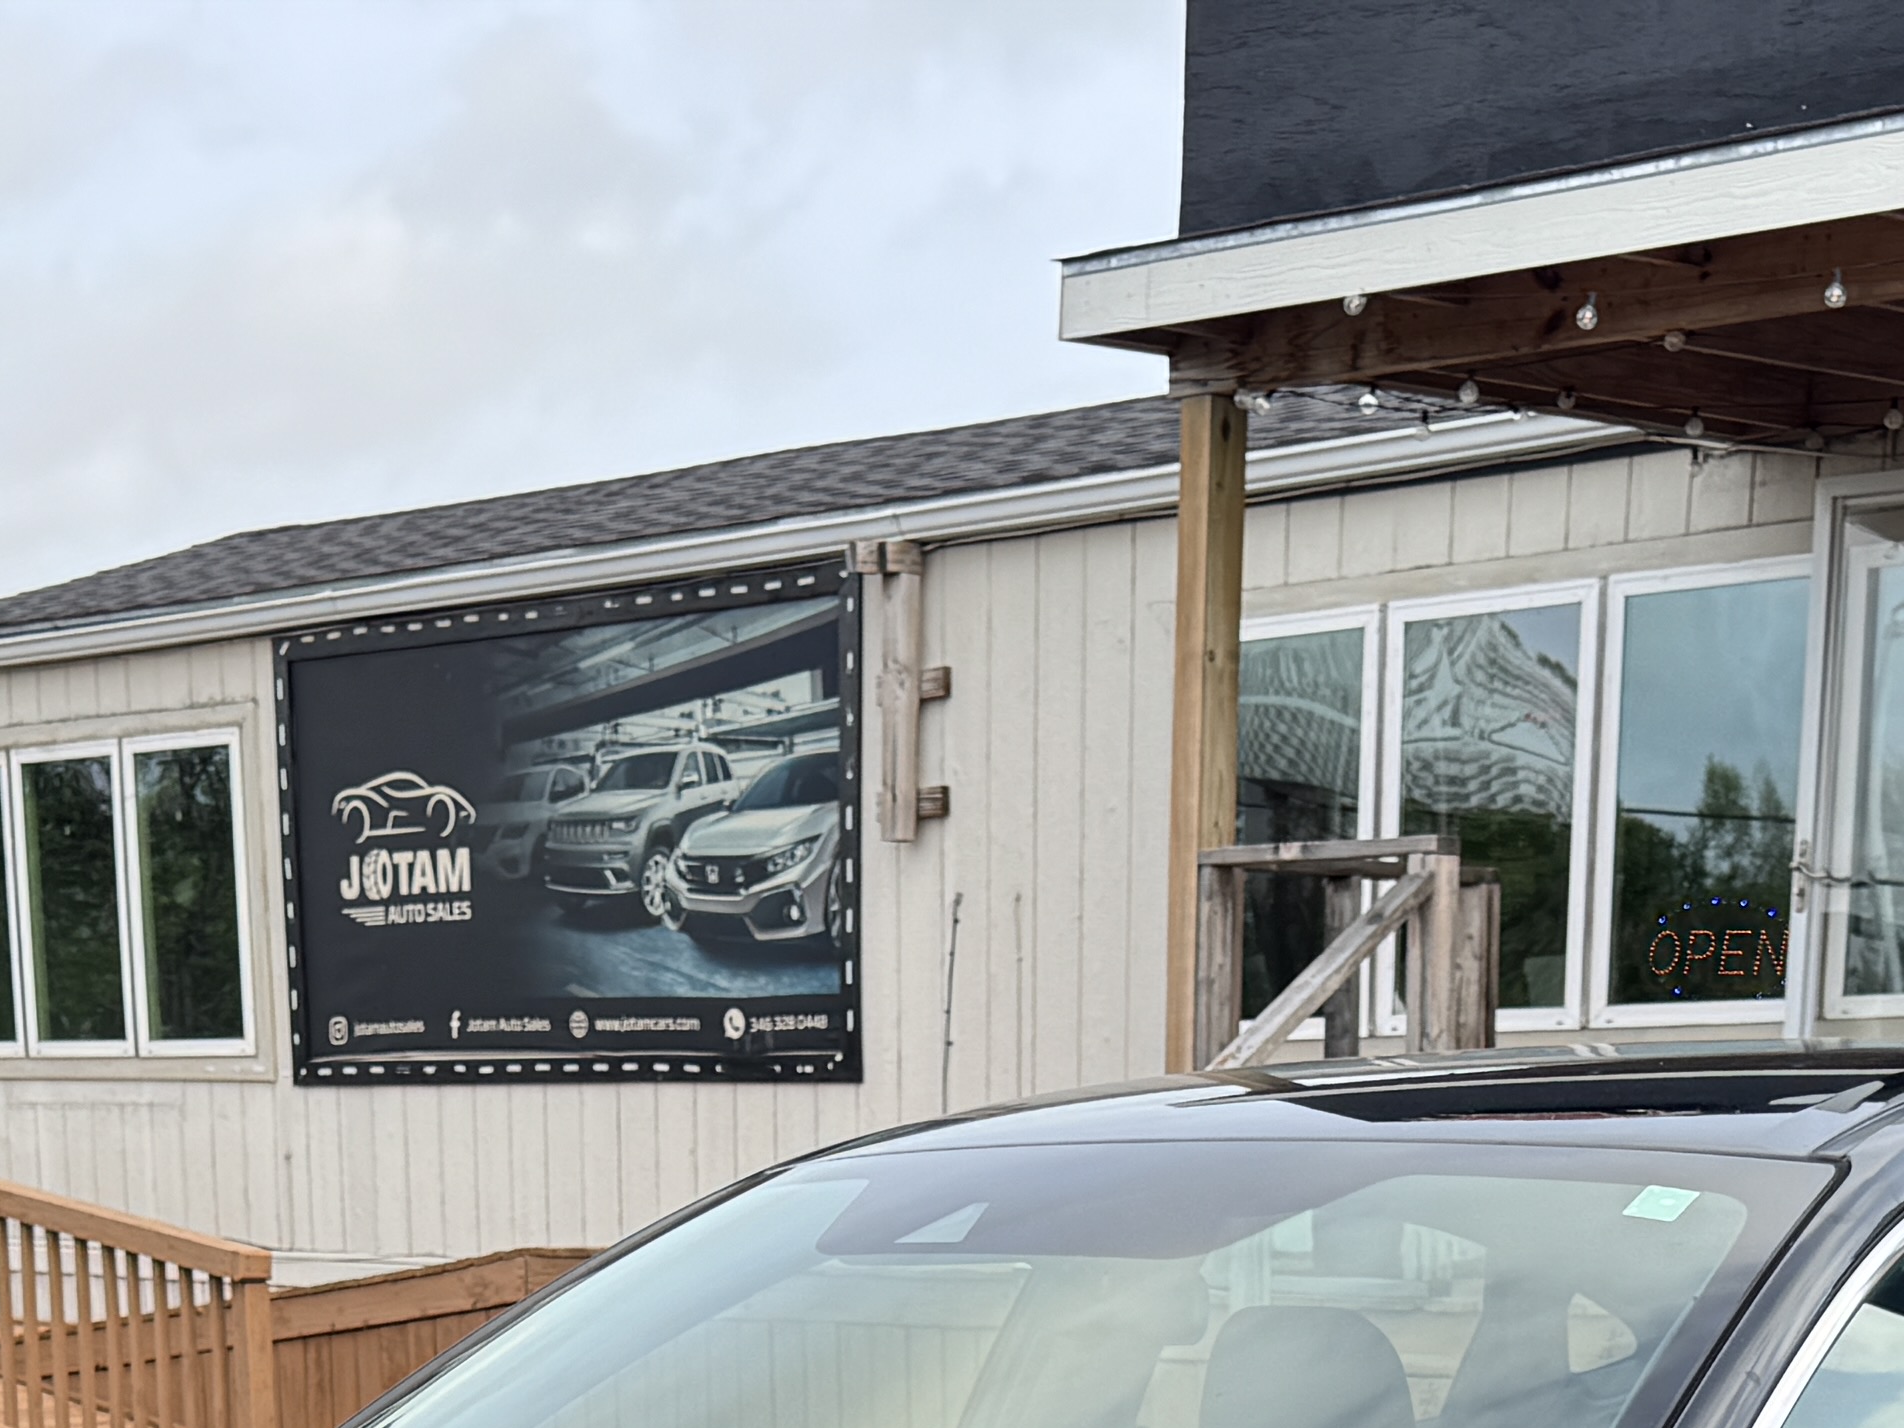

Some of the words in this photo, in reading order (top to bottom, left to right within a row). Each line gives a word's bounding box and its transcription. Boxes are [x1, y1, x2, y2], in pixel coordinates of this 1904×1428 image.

[340, 848, 471, 901] JOTAM
[387, 903, 426, 925] AUTO
[426, 901, 473, 922] SALES
[1649, 929, 1790, 976] OPEN
